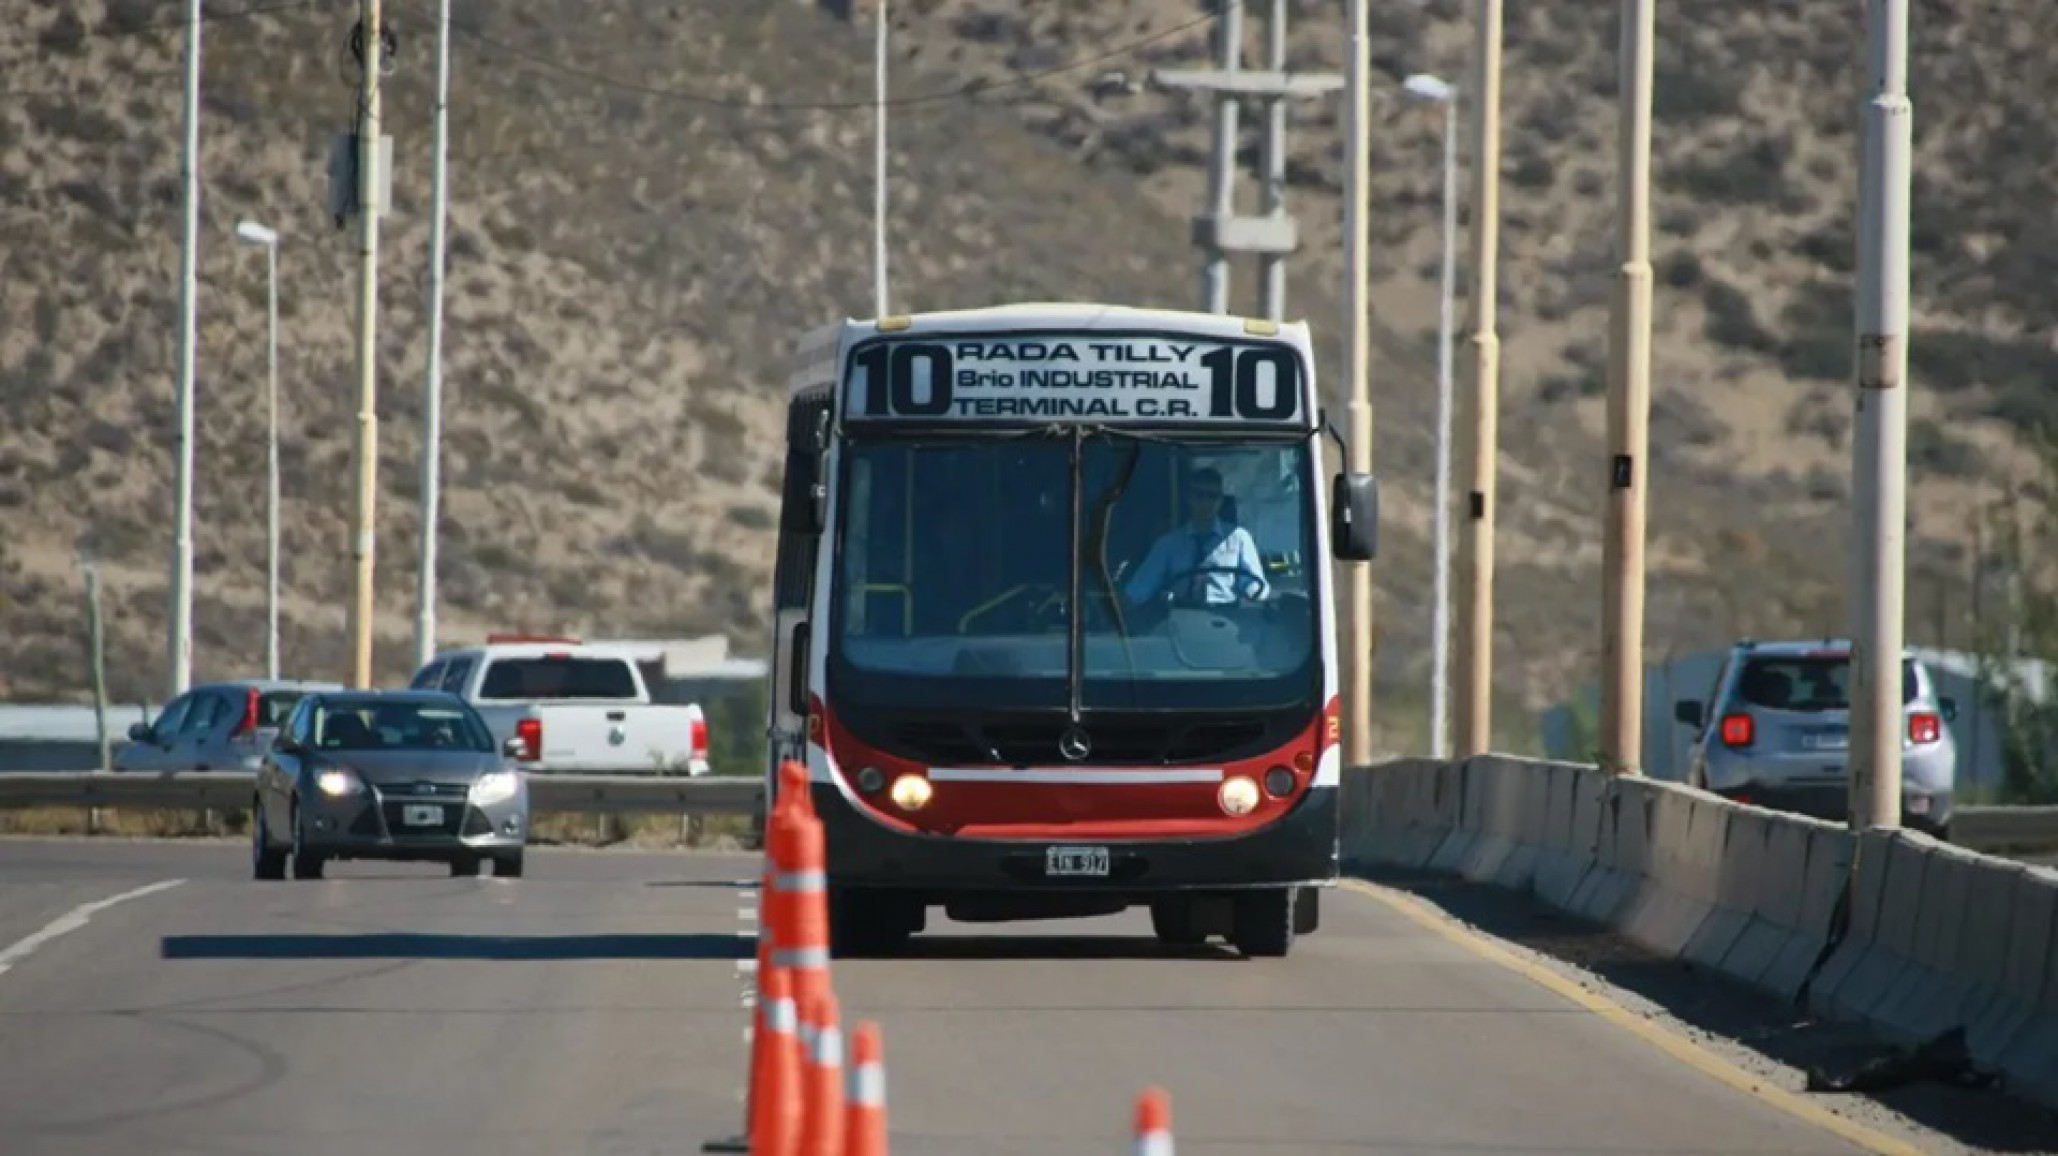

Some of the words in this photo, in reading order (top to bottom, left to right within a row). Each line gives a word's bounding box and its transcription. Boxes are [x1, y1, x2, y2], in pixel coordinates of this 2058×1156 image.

[956, 343, 1080, 361] RADA
[1089, 344, 1195, 361] TILLY
[857, 344, 952, 416] 10
[957, 369, 1015, 387] Brio
[1019, 370, 1199, 389] INDUSTRIAL
[1200, 347, 1297, 419] 10
[953, 398, 1128, 416] TERMINAL
[1136, 398, 1199, 417] C.R.
